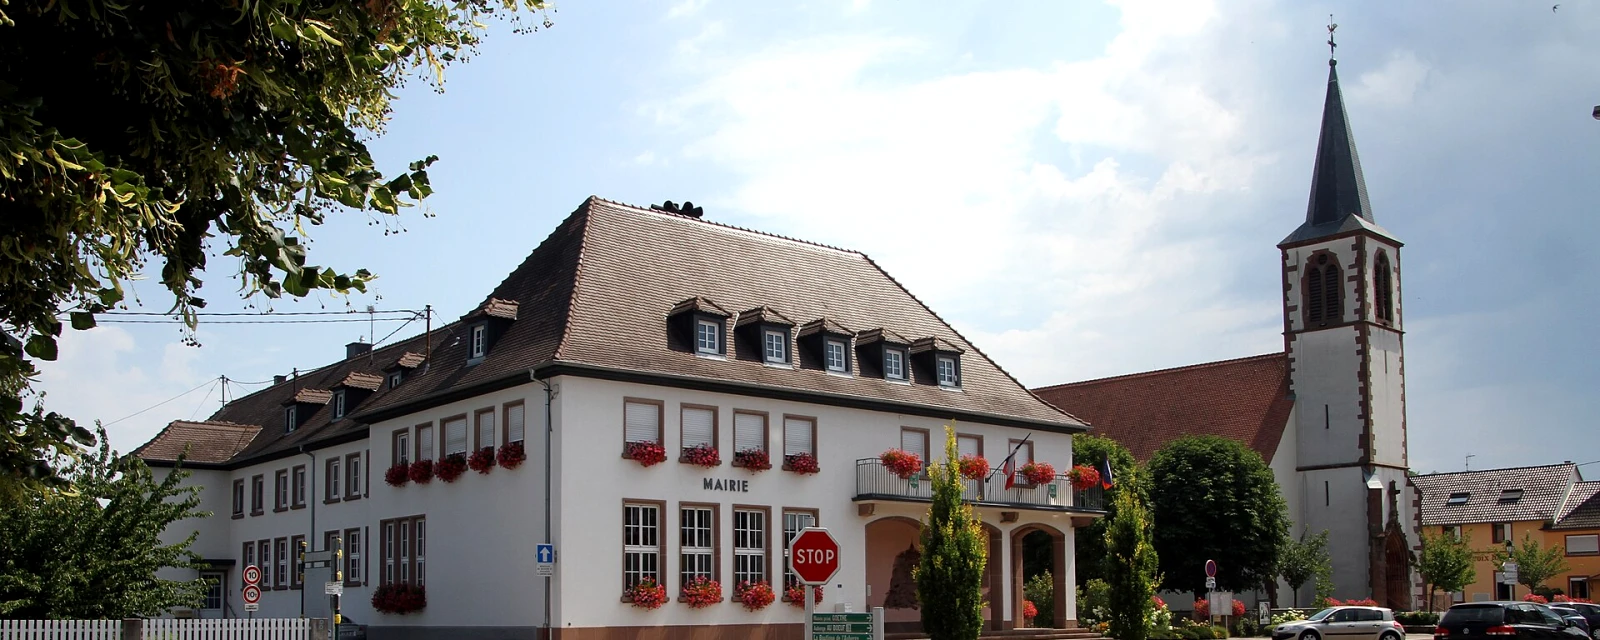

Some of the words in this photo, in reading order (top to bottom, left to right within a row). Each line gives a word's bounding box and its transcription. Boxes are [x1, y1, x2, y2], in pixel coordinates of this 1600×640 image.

[703, 477, 748, 492] MAIRIE
[797, 549, 834, 564] STOP
[248, 571, 257, 579] 10
